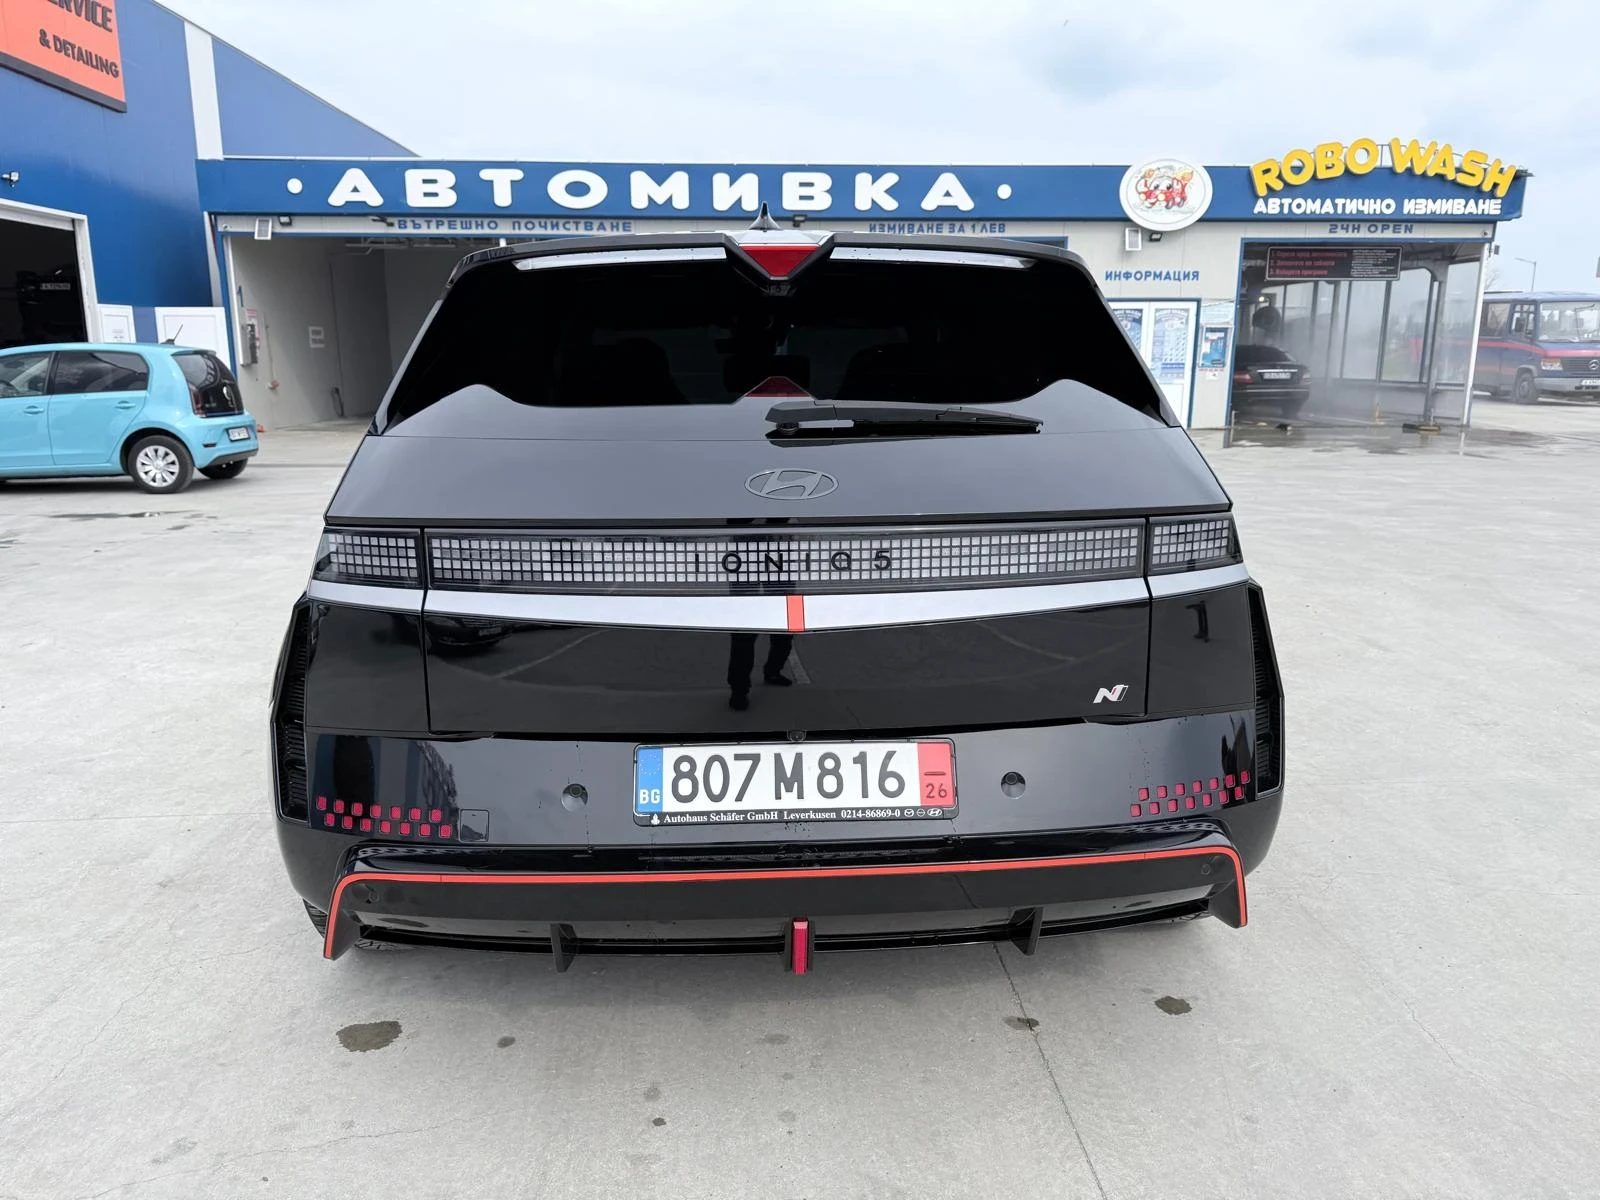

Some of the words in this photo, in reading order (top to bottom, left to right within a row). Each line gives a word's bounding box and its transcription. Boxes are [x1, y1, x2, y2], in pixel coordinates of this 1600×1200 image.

[39, 28, 51, 50] &
[53, 34, 119, 79] DETAILING
[1250, 137, 1380, 197] ROBO
[1389, 137, 1517, 198] WASH
[327, 167, 975, 214] АВТОМИВКА
[1253, 197, 1397, 215] АВТОМАТИЧНО
[1402, 198, 1502, 215] ИЗМИВАНЕ
[397, 218, 498, 231] ВЪТРЕШНО
[511, 219, 633, 233] ПОЧИСТВАНЕ
[868, 222, 944, 234] ИЗМИВАНЕ
[947, 222, 966, 234] ЗА
[970, 222, 977, 233] 1
[979, 222, 1006, 234] ЛЕВ
[1328, 223, 1361, 234] 24H
[1367, 223, 1414, 234] OPEN
[1104, 270, 1200, 282] ИНФОРМАЦИЯ
[639, 788, 661, 804] BG
[925, 783, 948, 799] 26
[664, 813, 707, 824] Autohaus
[709, 812, 746, 823] Schäfer
[747, 811, 779, 821] GmbH
[783, 810, 837, 820] Leverkusen
[840, 808, 901, 819] 0214-86869-0
